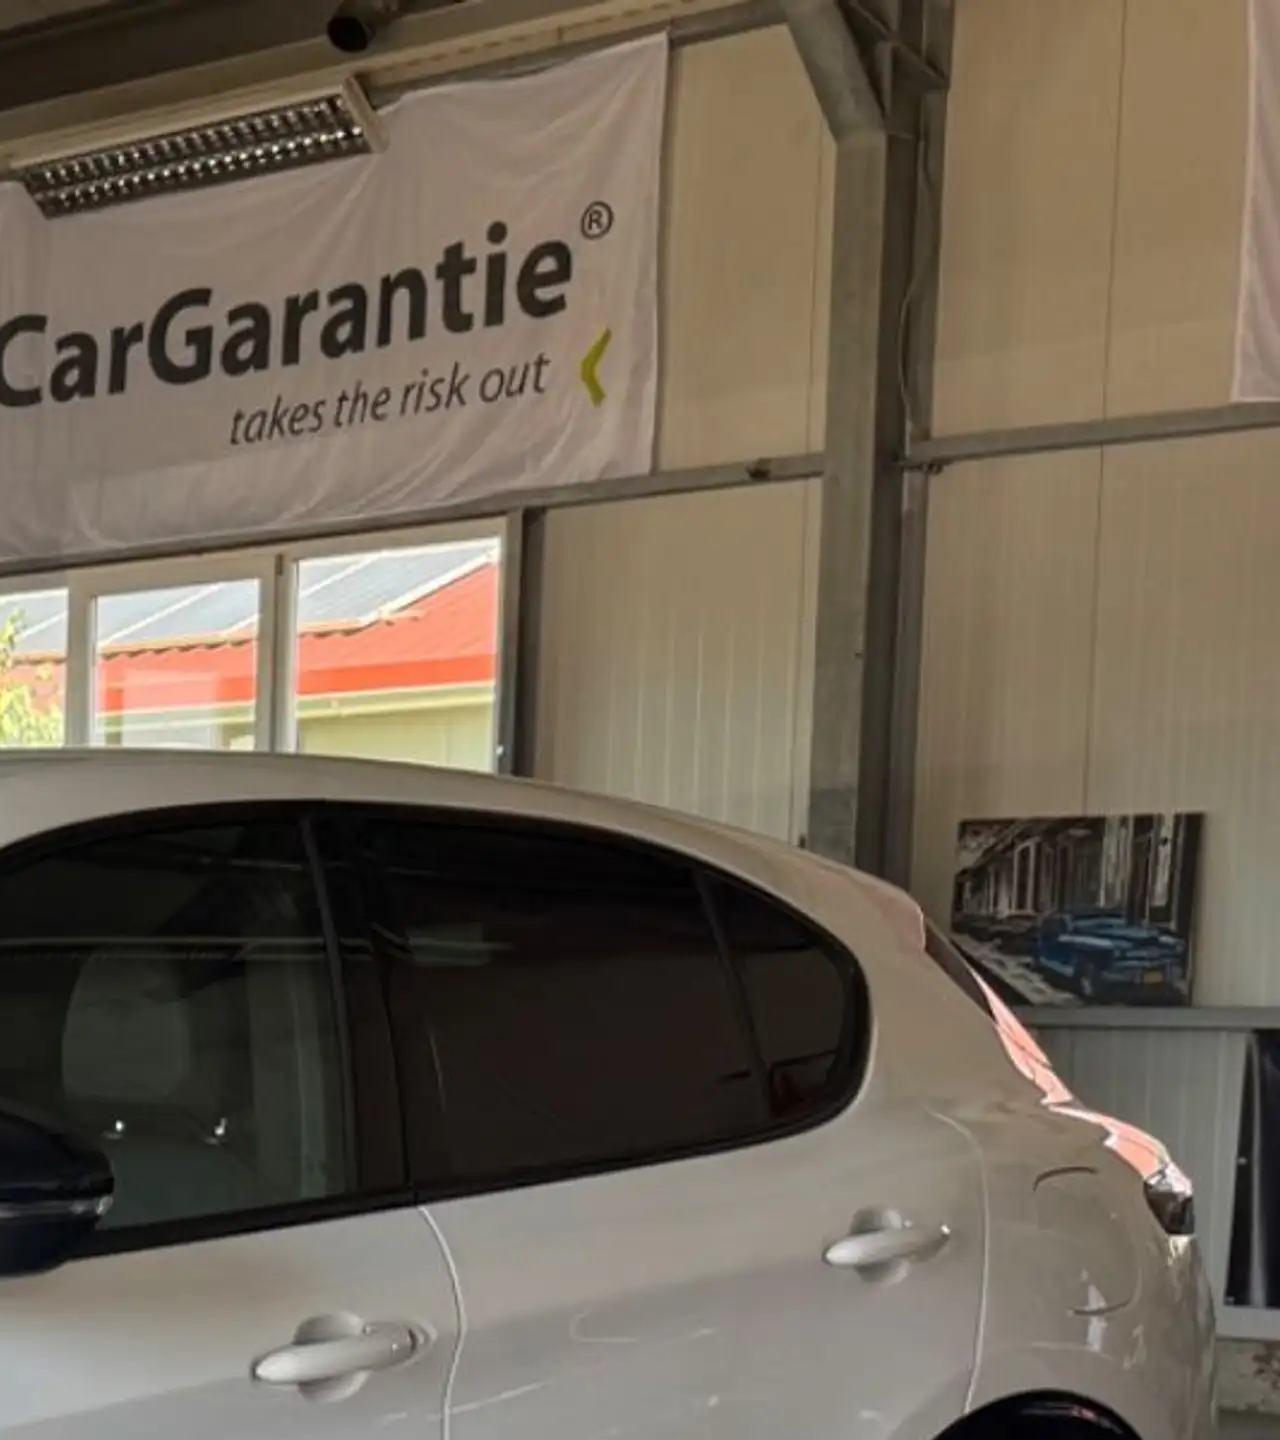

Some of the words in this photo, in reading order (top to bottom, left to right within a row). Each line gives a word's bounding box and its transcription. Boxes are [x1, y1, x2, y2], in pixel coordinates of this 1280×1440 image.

[230, 395, 326, 446] takes
[334, 379, 390, 428] the
[399, 361, 471, 416] risk
[478, 352, 551, 404] out
